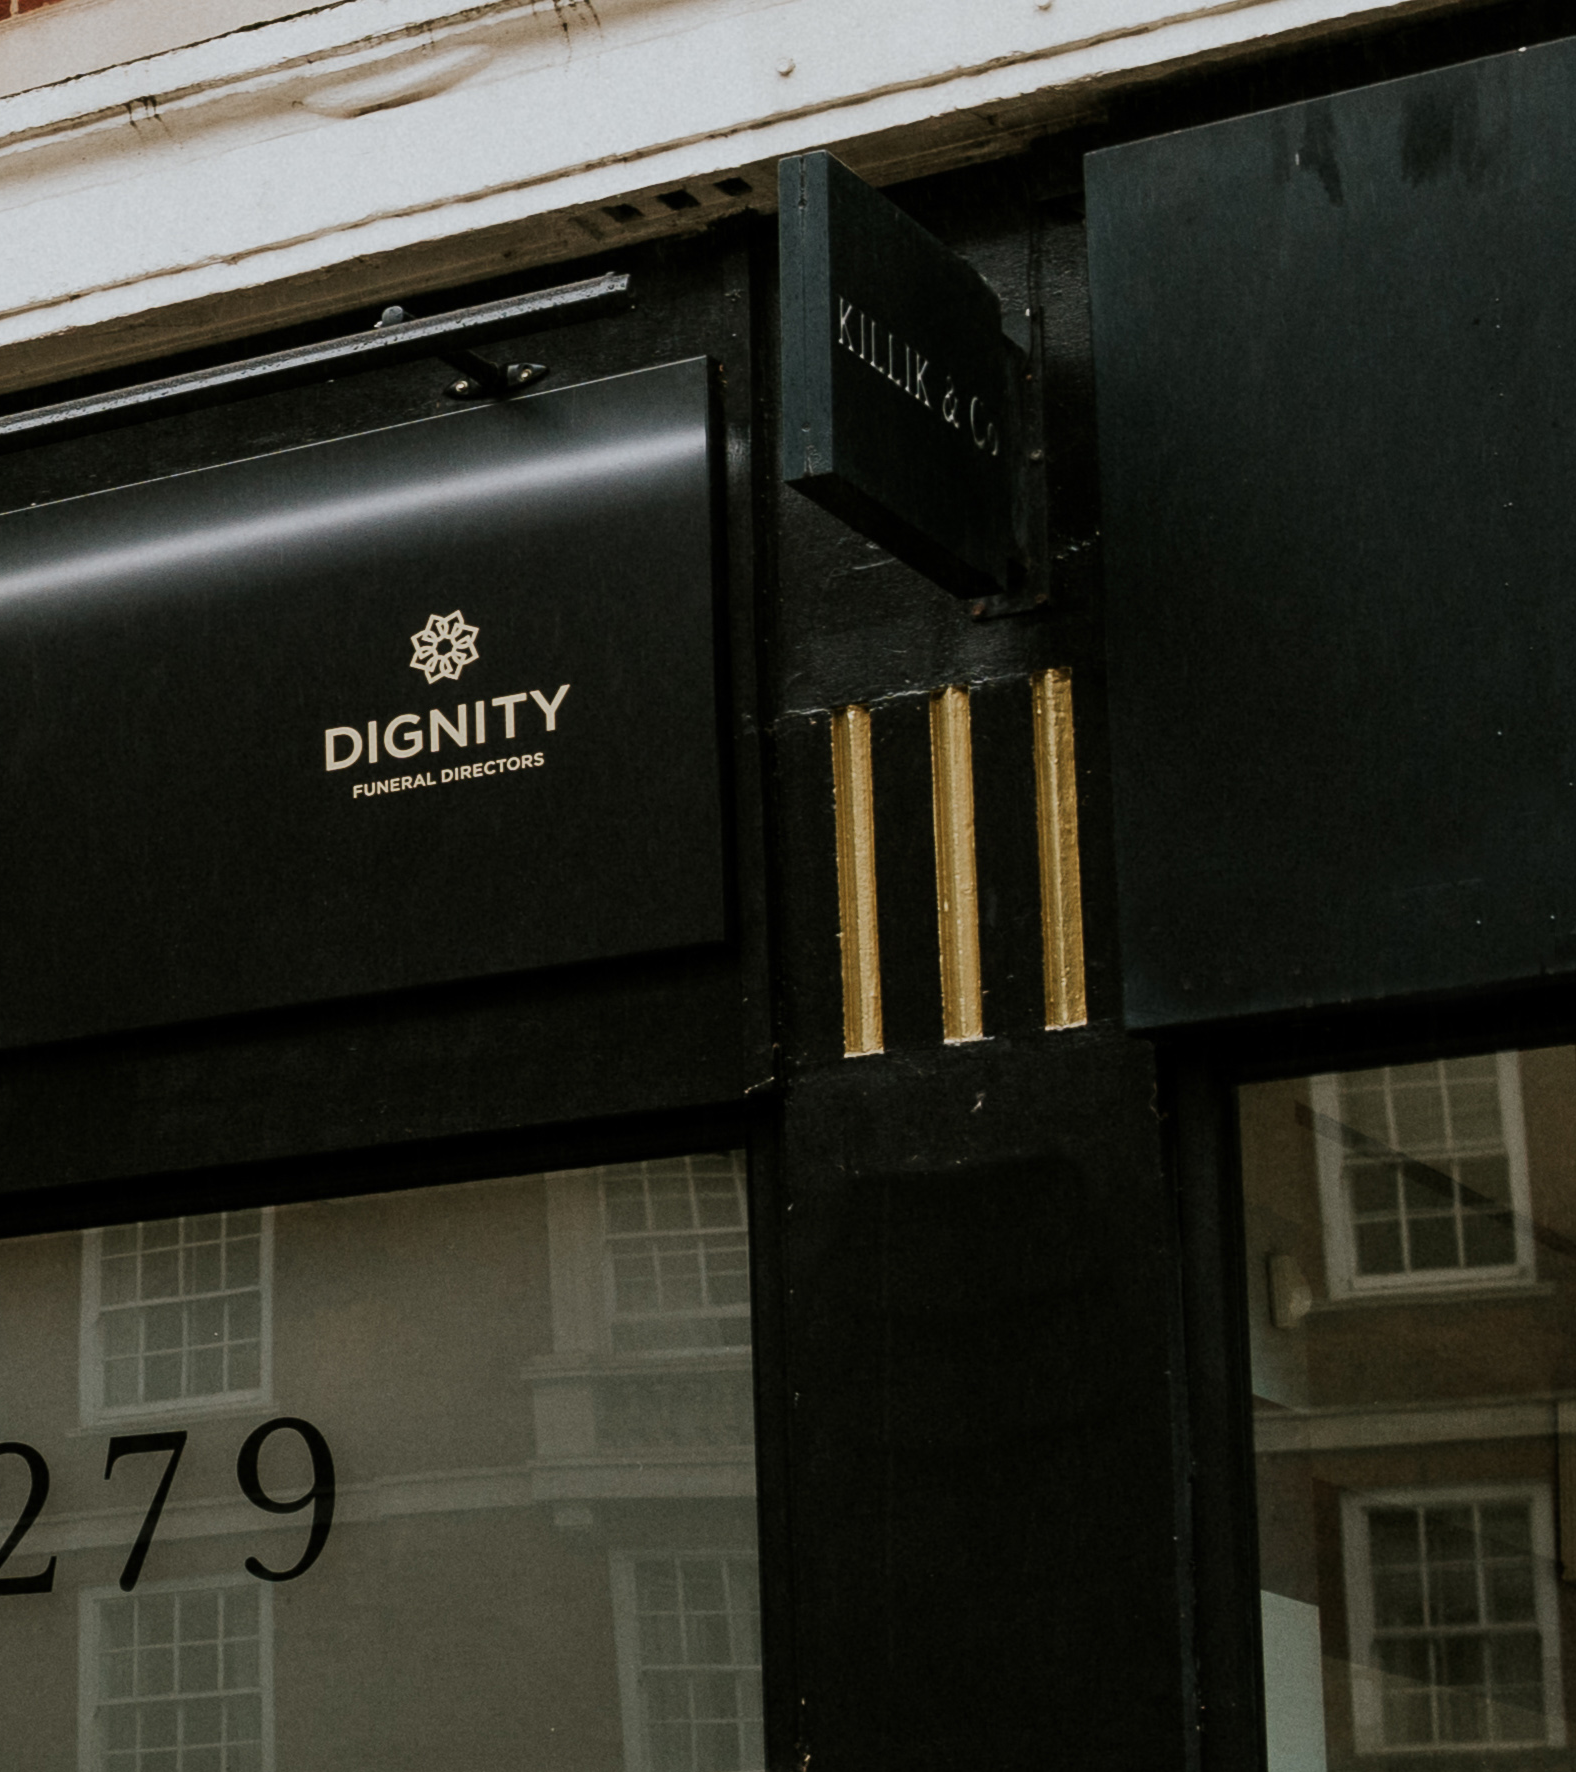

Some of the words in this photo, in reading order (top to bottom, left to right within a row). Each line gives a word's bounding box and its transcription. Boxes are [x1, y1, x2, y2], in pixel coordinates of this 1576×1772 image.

[837, 297, 933, 410] KILLIK
[943, 376, 961, 430] &
[324, 684, 571, 771] DIGNITY
[353, 772, 436, 799] FUNERAL
[441, 752, 545, 784] DIRECTORS
